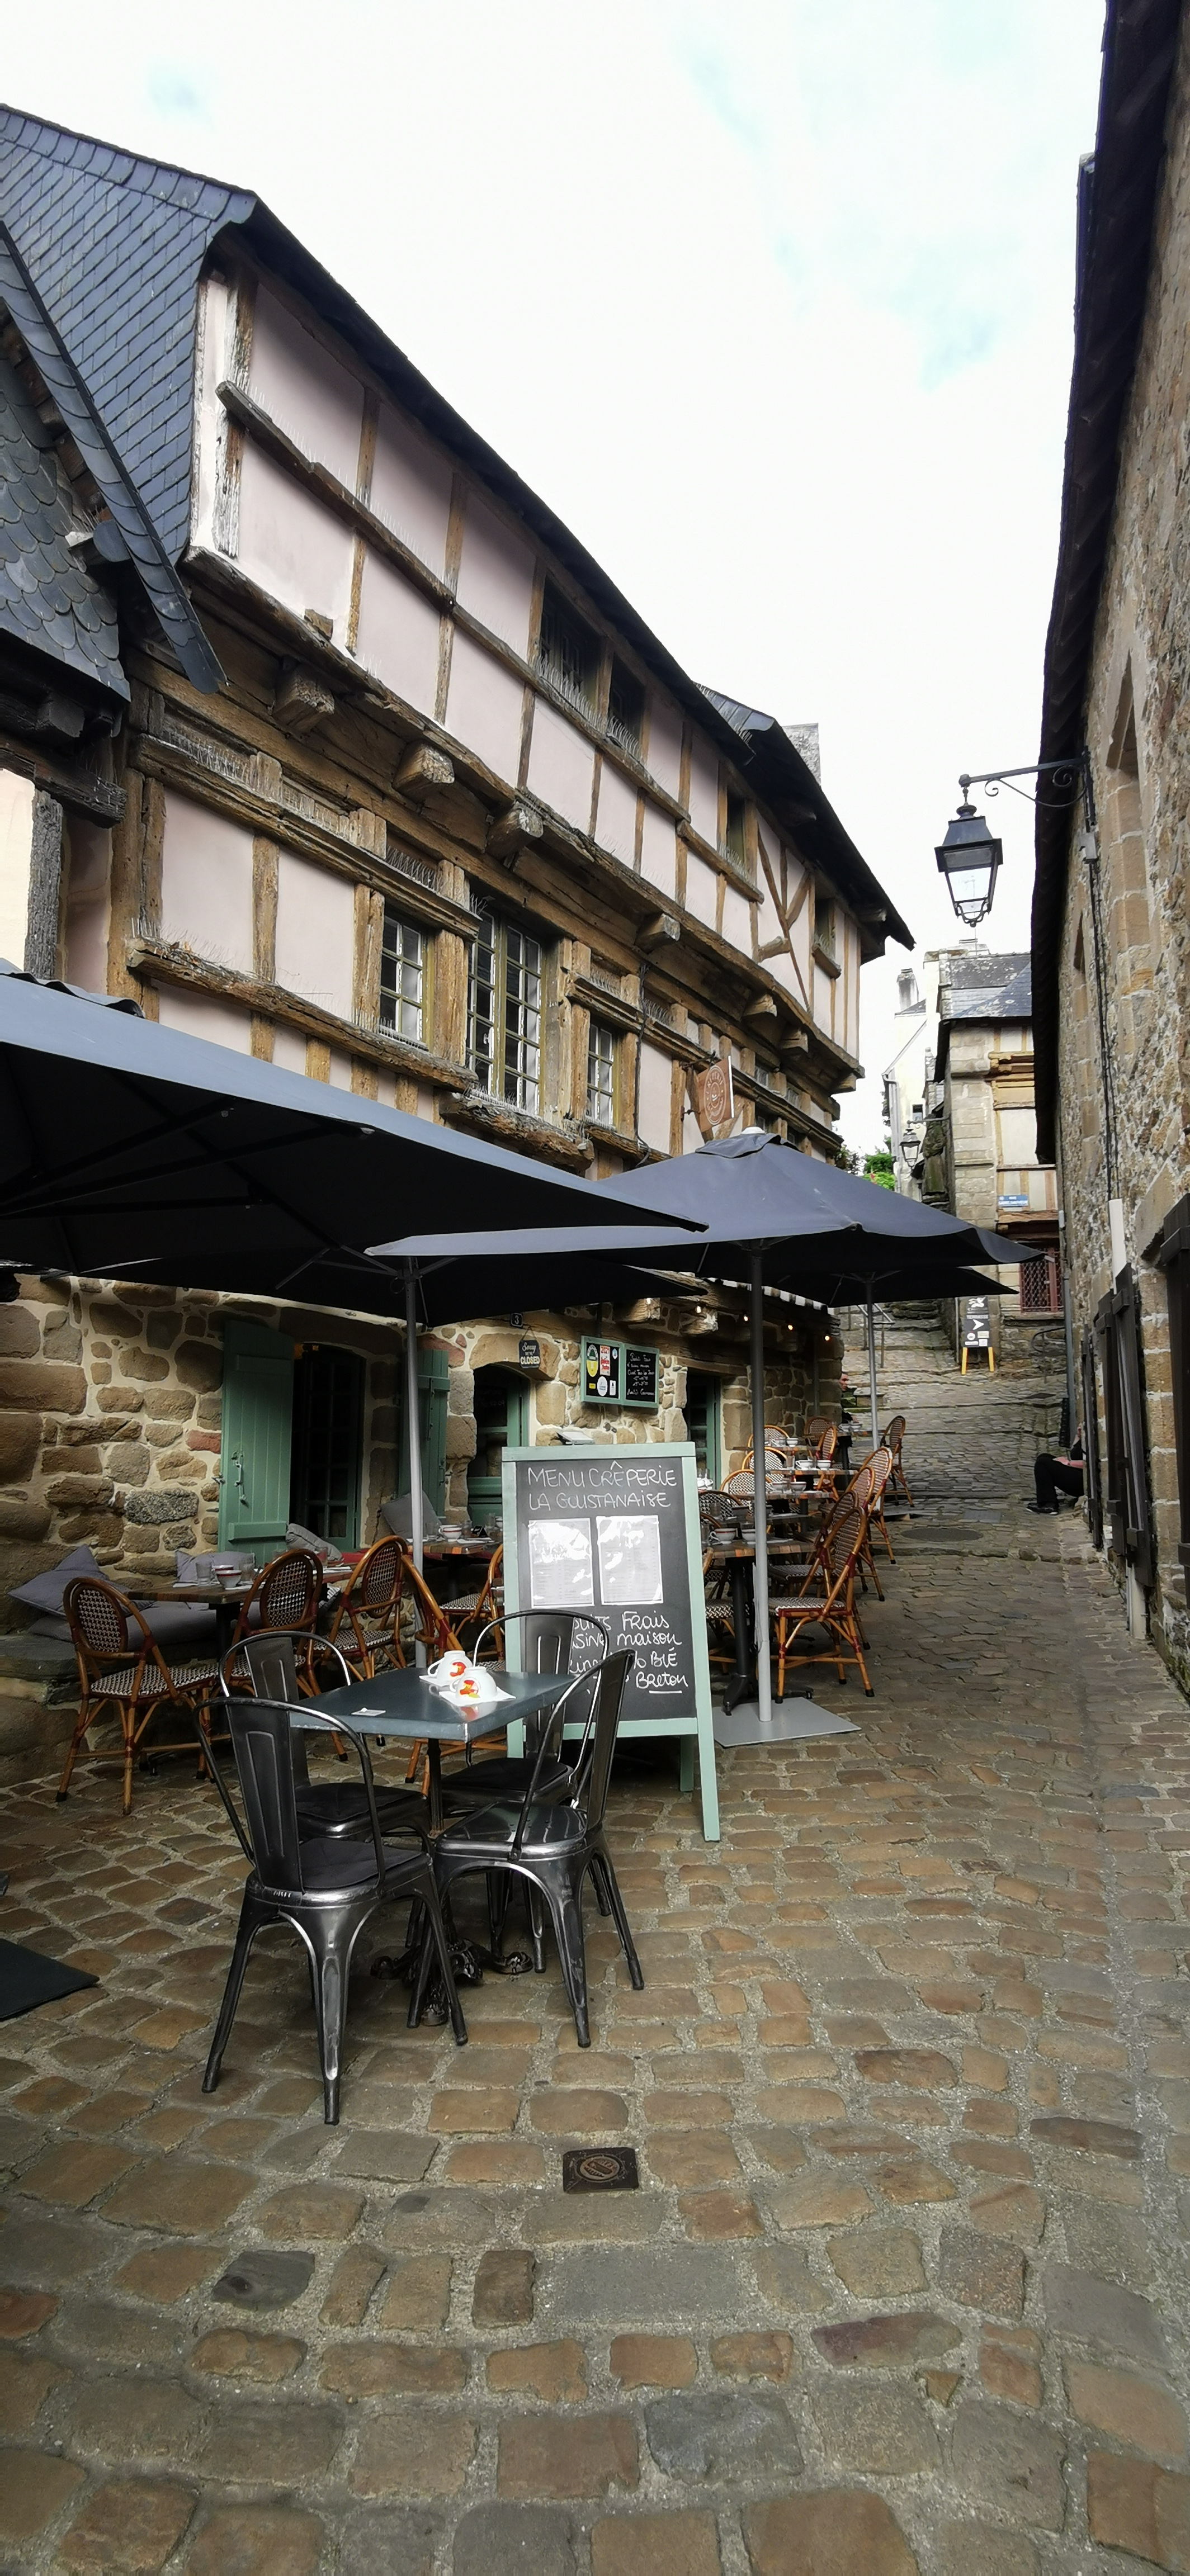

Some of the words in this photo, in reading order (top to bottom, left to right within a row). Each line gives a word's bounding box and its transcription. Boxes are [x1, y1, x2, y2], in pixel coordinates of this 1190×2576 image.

[514, 1315, 519, 1324] 3
[521, 1356, 540, 1365] CLOSED
[528, 1467, 585, 1488] MENU
[529, 1493, 551, 1510] LA
[617, 1631, 682, 1646] maison
